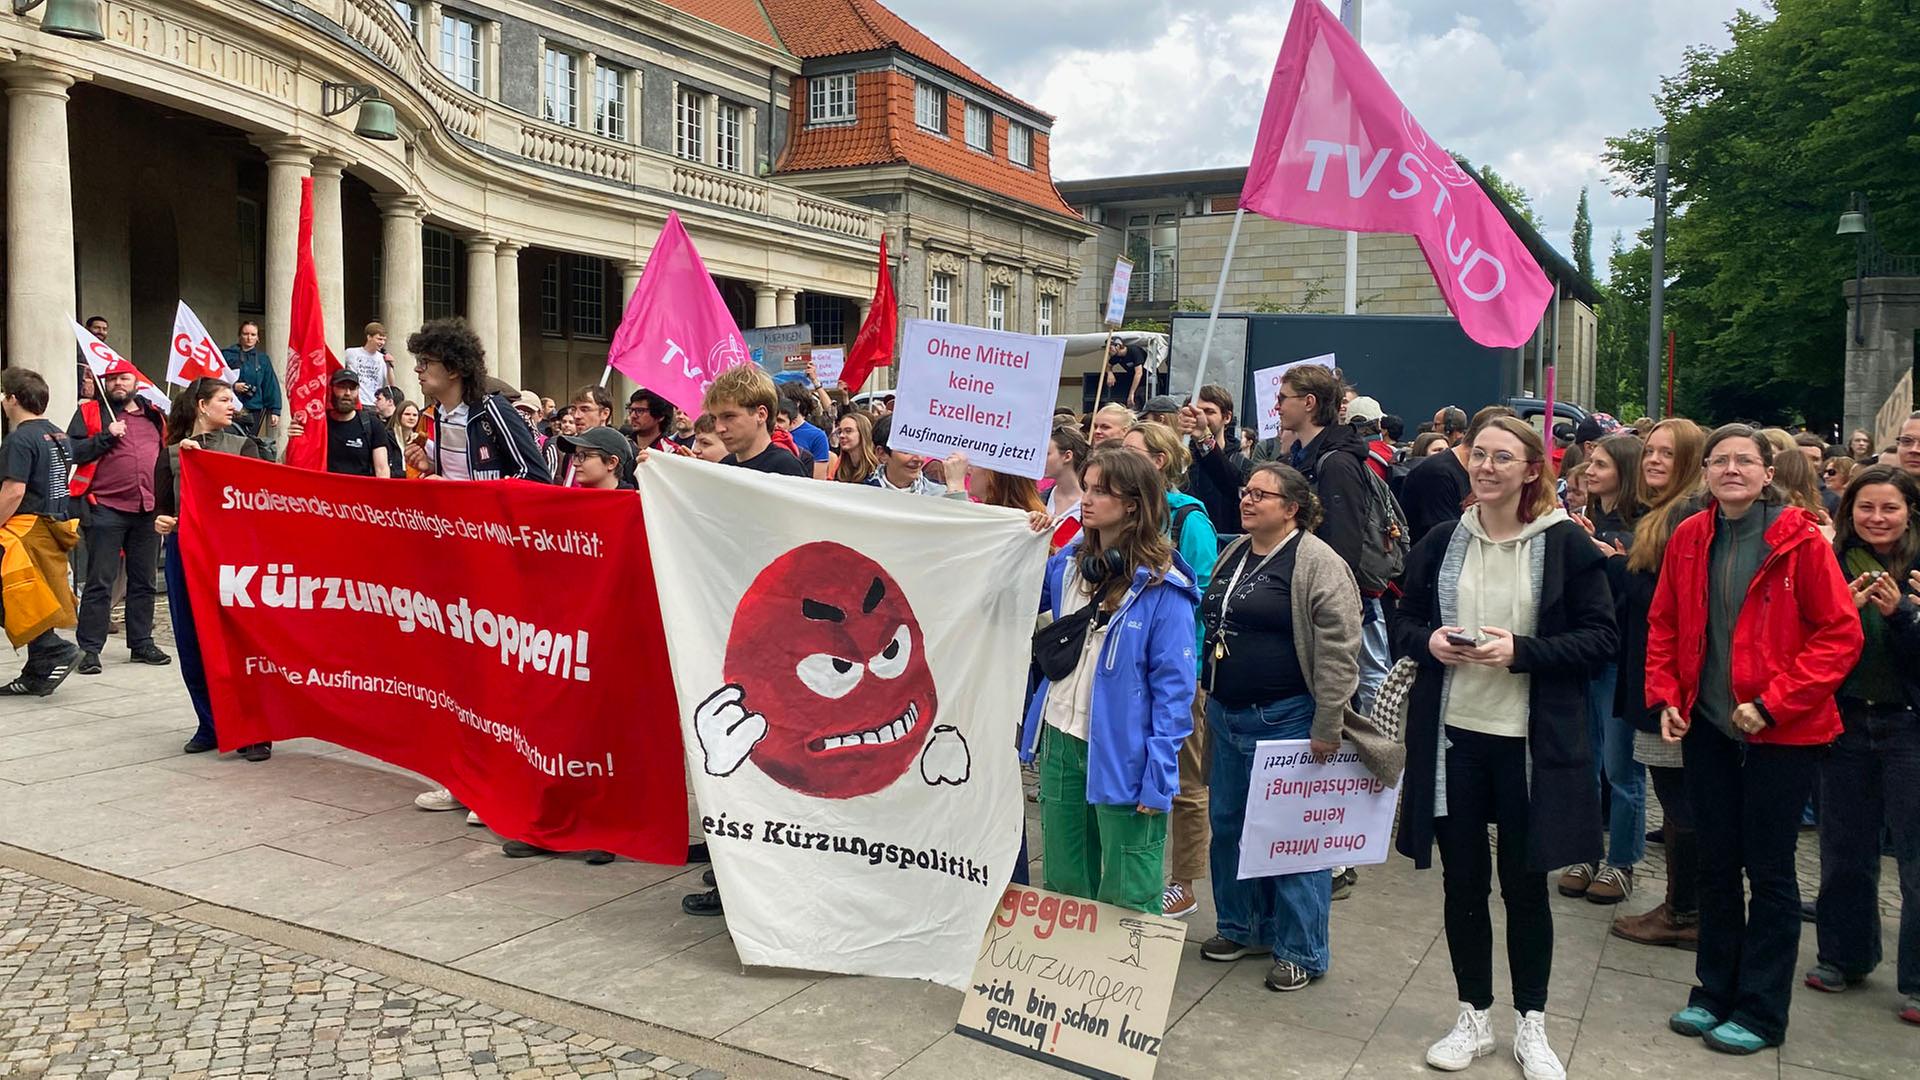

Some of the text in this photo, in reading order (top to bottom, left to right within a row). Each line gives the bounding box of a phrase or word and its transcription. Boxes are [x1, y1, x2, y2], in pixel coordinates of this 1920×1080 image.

[927, 338, 1030, 369] Ohne Mittel
[948, 371, 995, 394] keine
[929, 398, 1012, 429] Exzellenz!
[899, 424, 1036, 461] Ausfinanzierung jetzt!
[221, 485, 334, 518] Studierende
[333, 502, 367, 523] und
[364, 504, 456, 539] Beschäftigte
[455, 516, 484, 540] der
[218, 563, 591, 682] Kürzungen stoppen!
[306, 667, 438, 710] Ausfinanzierung
[455, 701, 514, 743] amburger
[1264, 752, 1300, 770] jetzt!
[1303, 807, 1346, 825] keine
[702, 812, 989, 887] eiss Kürzungspolitik!
[1269, 834, 1367, 859] Ohne Mittel
[996, 888, 1098, 939] gegen
[979, 925, 1144, 1017] Kürzungen
[987, 978, 1162, 1057] ich bin schon kurz
